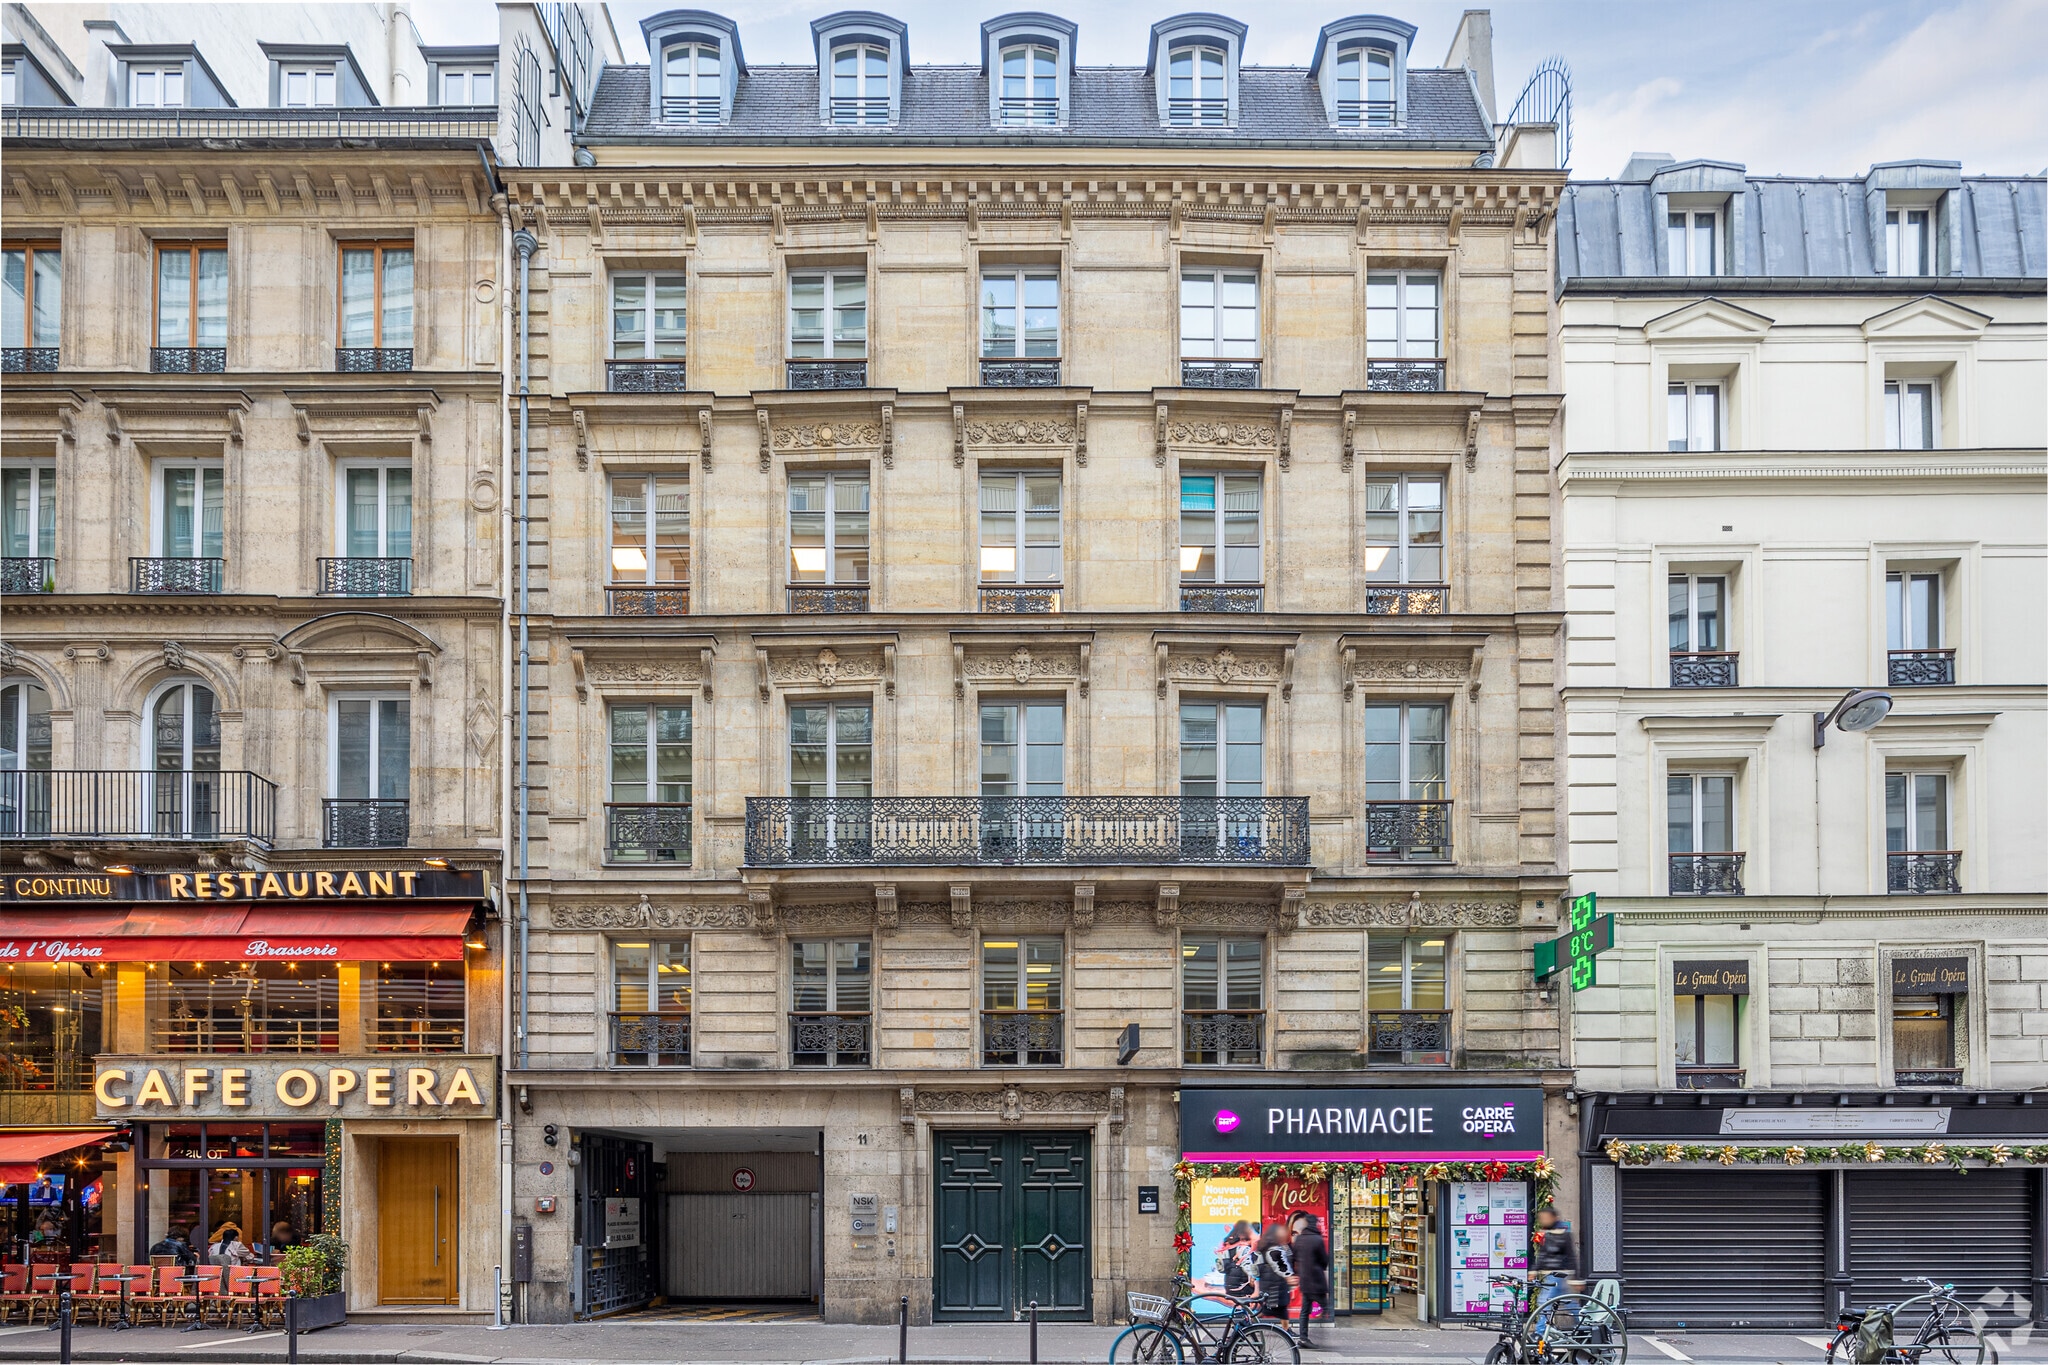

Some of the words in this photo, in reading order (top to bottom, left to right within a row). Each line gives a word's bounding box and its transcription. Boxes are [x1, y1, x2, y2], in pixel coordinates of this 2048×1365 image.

[16, 878, 110, 896] CONTINU
[169, 871, 418, 898] RESTAURANT
[0, 941, 20, 957] de
[245, 940, 338, 956] Brasserie
[1675, 971, 1688, 986] Le
[1692, 969, 1718, 988] Grand
[1722, 968, 1747, 990] Opéra
[1894, 969, 1906, 984] Le
[1911, 967, 1937, 989] Grand
[1941, 966, 1967, 985] Opéra
[94, 1068, 251, 1107] CAFE
[275, 1067, 485, 1107] OPERA
[1268, 1108, 1434, 1134] PHARMACIE
[1204, 1185, 1247, 1195] Nouveau
[1271, 1181, 1320, 1211] Noël
[853, 1197, 874, 1206] NSK
[1209, 1207, 1243, 1217] BIOTIC
